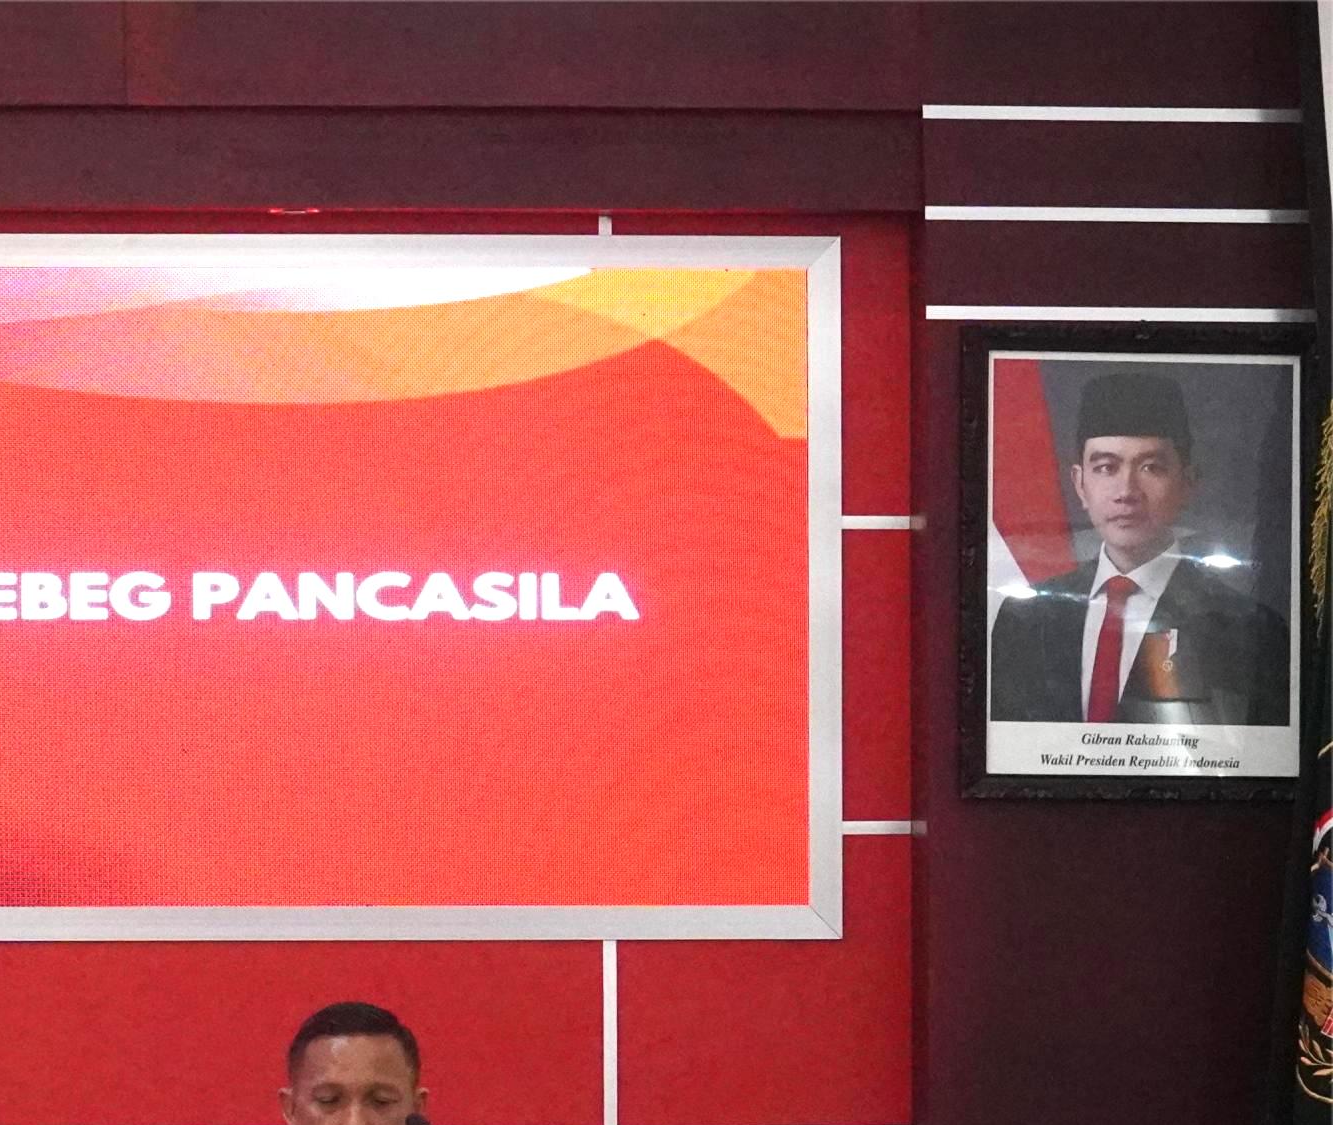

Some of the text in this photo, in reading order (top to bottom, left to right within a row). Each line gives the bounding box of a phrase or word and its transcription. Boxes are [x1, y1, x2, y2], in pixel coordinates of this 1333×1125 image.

[191, 570, 641, 622] PANCASILA
[1081, 732, 1122, 745] Gibran
[1041, 754, 1240, 770] Wakil Presiden Republik Indonesia
